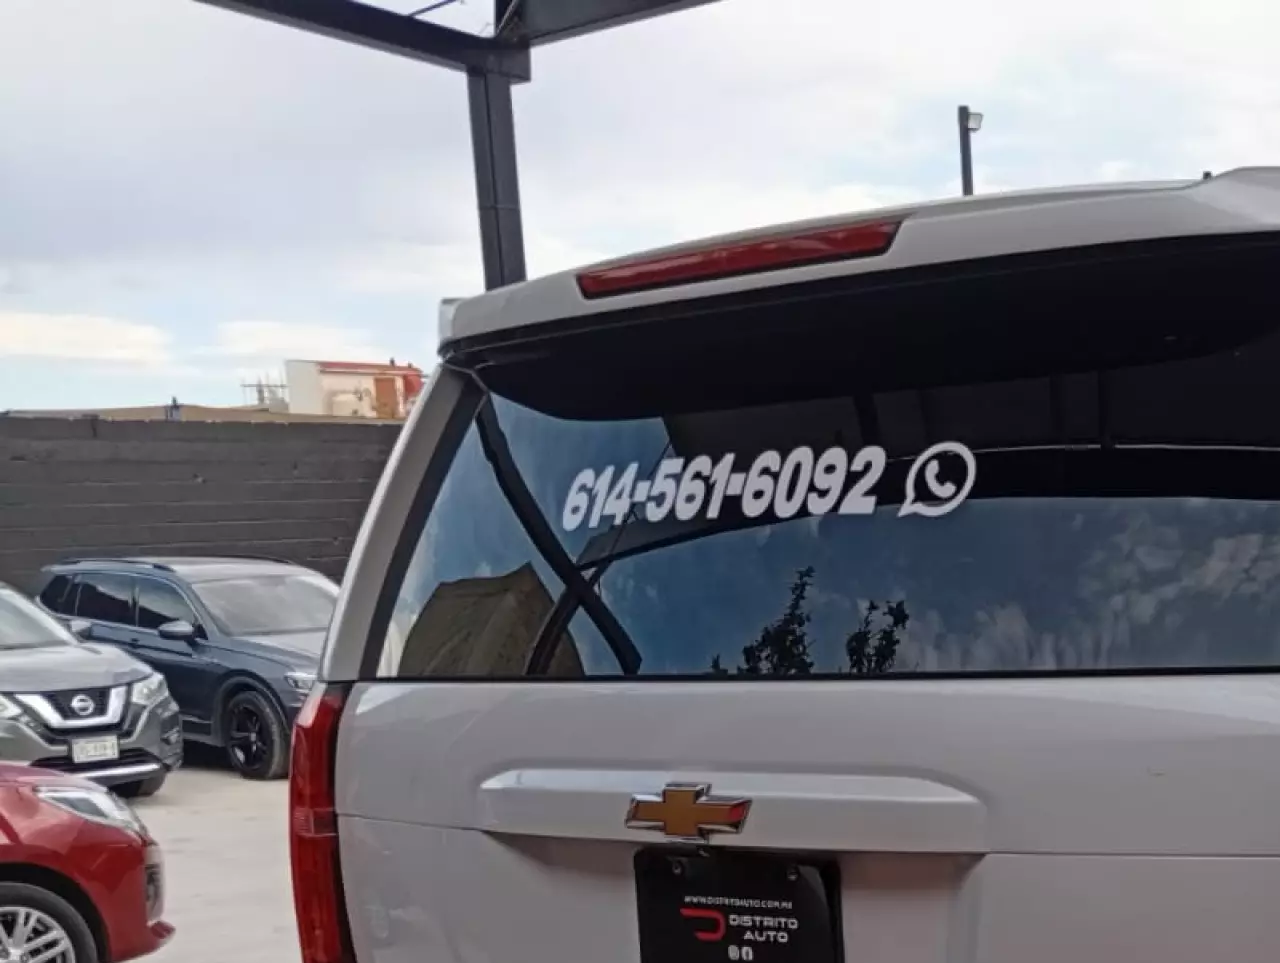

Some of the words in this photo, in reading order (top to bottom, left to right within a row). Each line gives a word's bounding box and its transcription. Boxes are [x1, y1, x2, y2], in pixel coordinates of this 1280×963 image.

[562, 445, 887, 532] 614-561-6092
[728, 914, 799, 929] DISTRITO
[743, 930, 788, 943] AUTO
